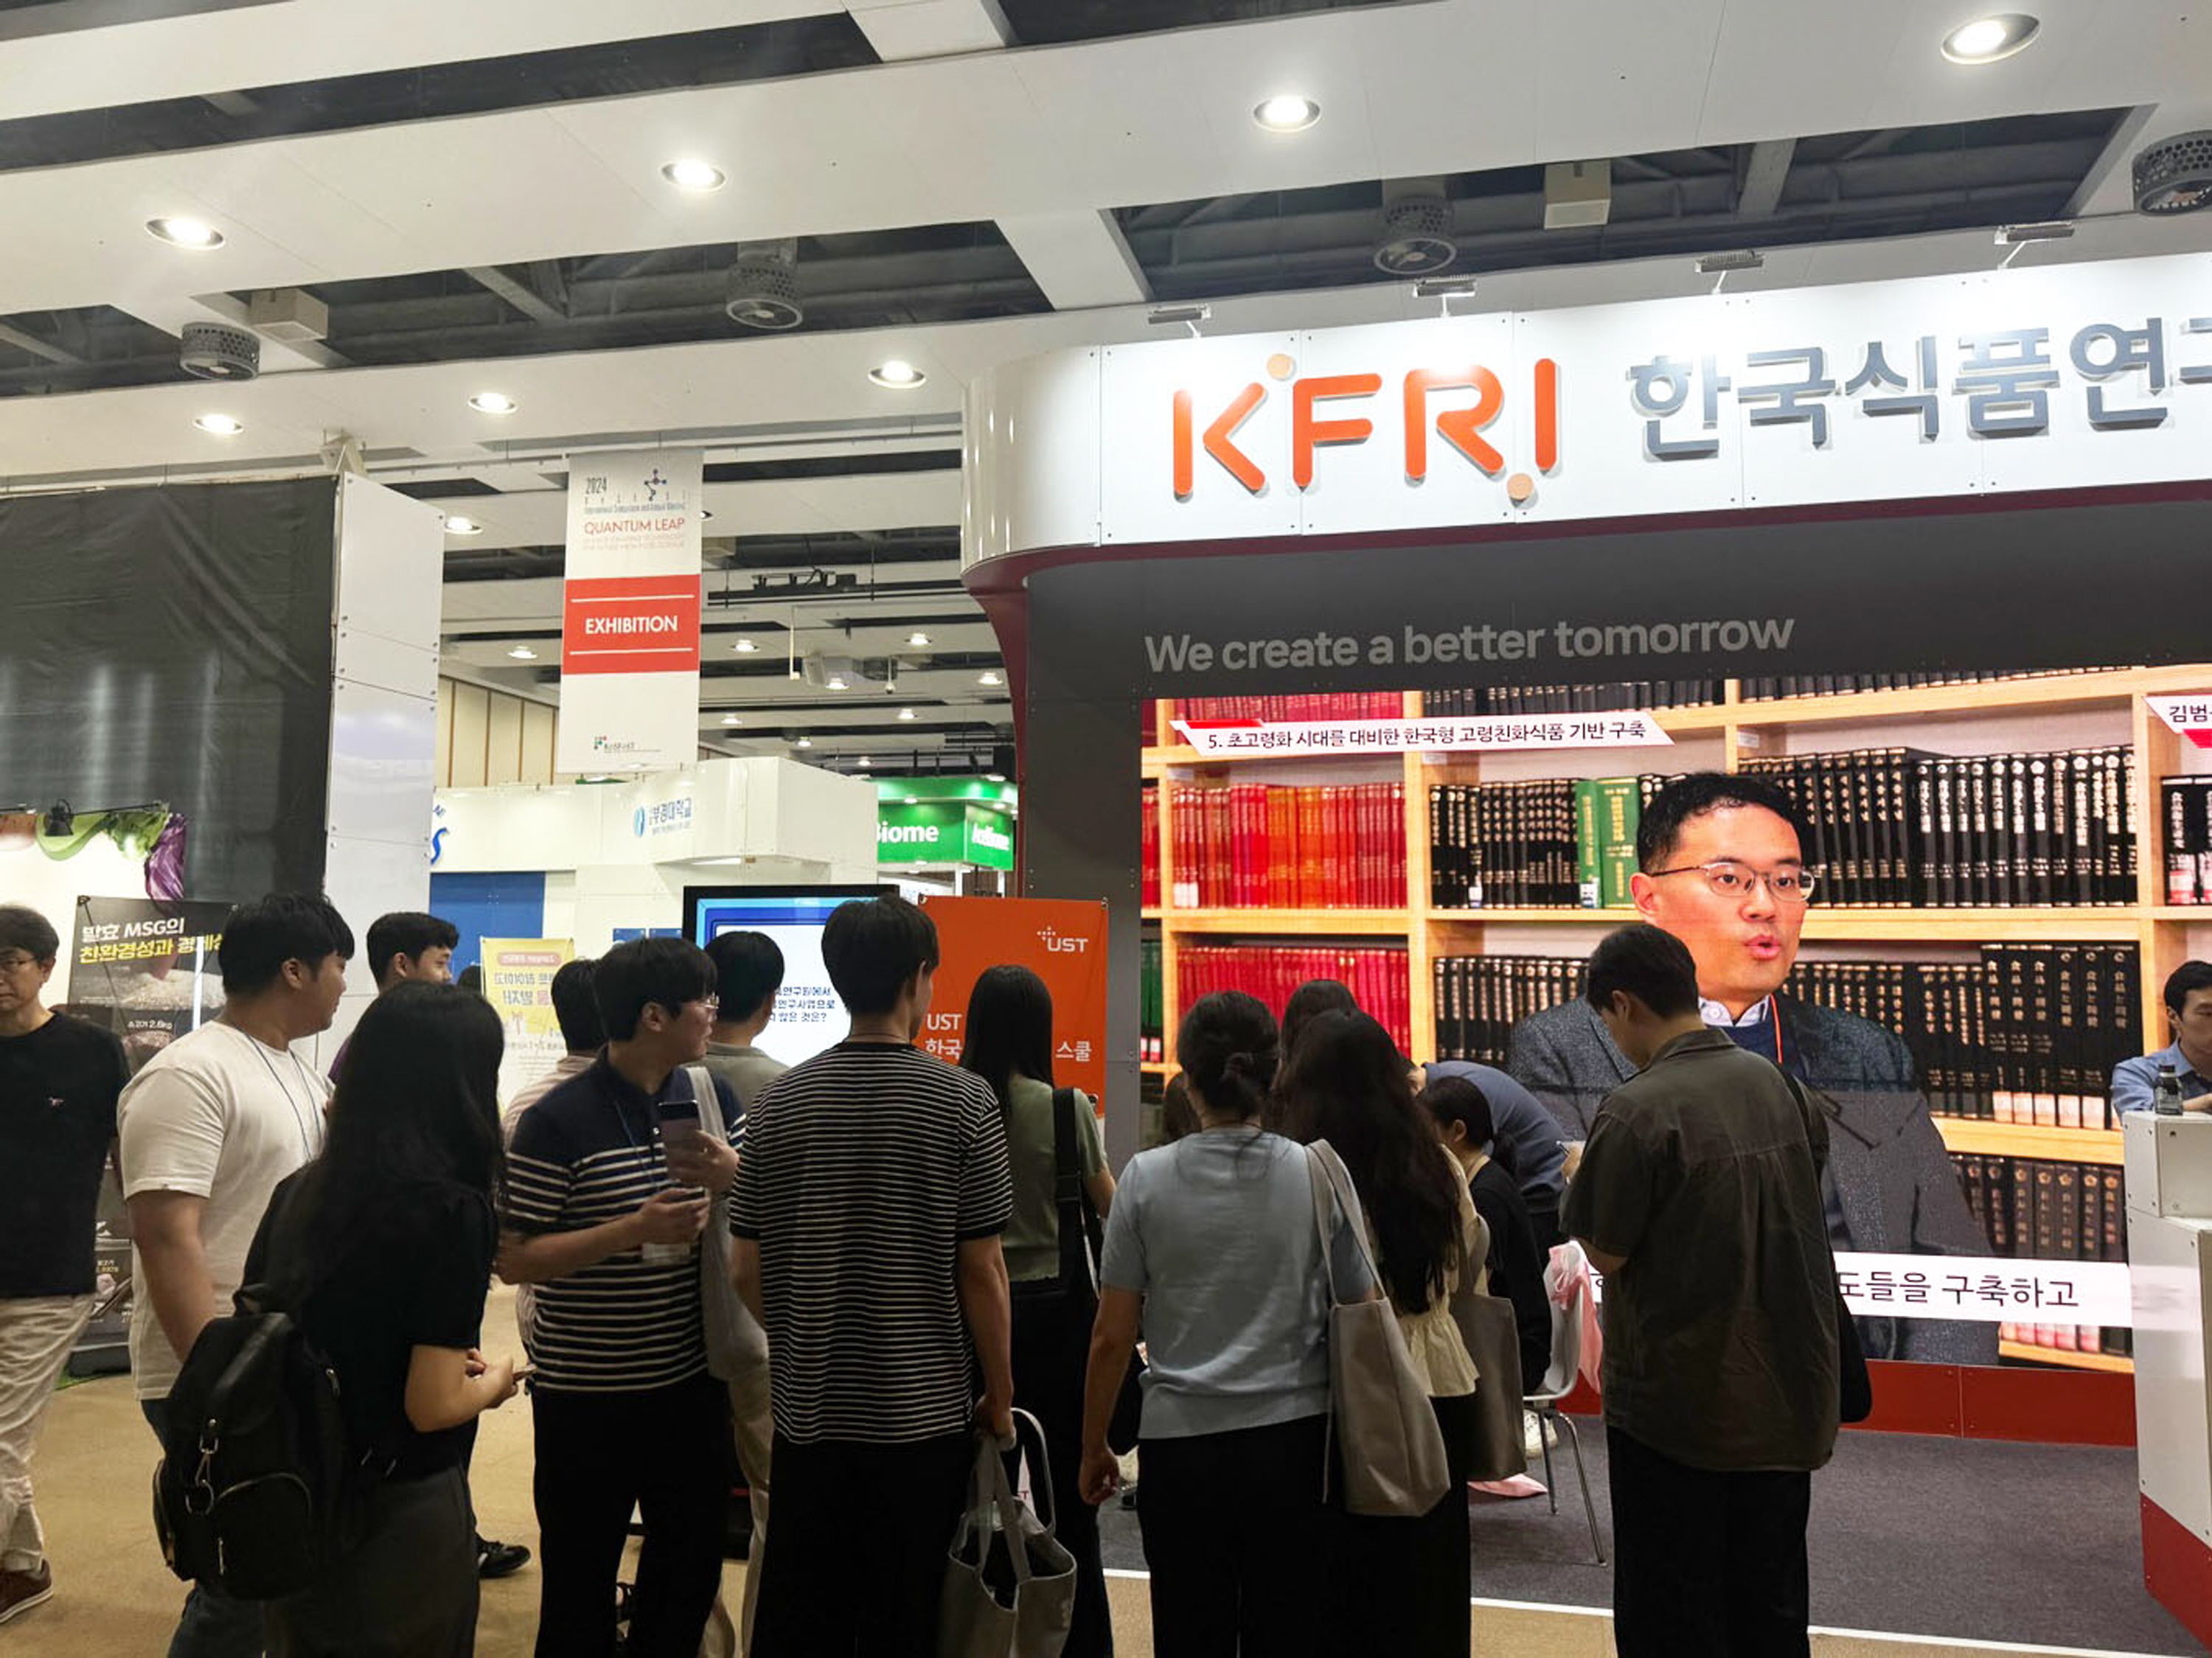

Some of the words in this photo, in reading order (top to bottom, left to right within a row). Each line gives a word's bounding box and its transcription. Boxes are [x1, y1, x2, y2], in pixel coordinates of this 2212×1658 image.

[1173, 355, 1560, 504] KFRI
[585, 476, 607, 495] 2024
[585, 519, 651, 534] QUANTUM
[655, 517, 685, 532] LEAP
[585, 615, 678, 635] EXHIBITION
[1144, 634, 1214, 672] We
[1222, 631, 1359, 670] create
[1368, 634, 1394, 665] a
[1404, 624, 1545, 663] better
[1554, 619, 1795, 658] tomorrow
[2168, 704, 2212, 723] 김범
[1208, 734, 1223, 749] 5.
[1228, 731, 1291, 749] 초고령화
[1296, 729, 1346, 747] 시대를
[1349, 728, 1399, 745] 대비한
[1403, 726, 1455, 745] 한국형
[1459, 722, 1565, 742] 고령친화식품
[1569, 722, 1604, 740] 기반
[1609, 720, 1646, 739] 구축
[82, 924, 120, 943] 발효
[124, 917, 185, 938] MSG의
[79, 938, 174, 964] 친환경성과
[1047, 937, 1089, 953] UST
[926, 1012, 962, 1031] UST
[1941, 1275, 2079, 1309] 구축하고
